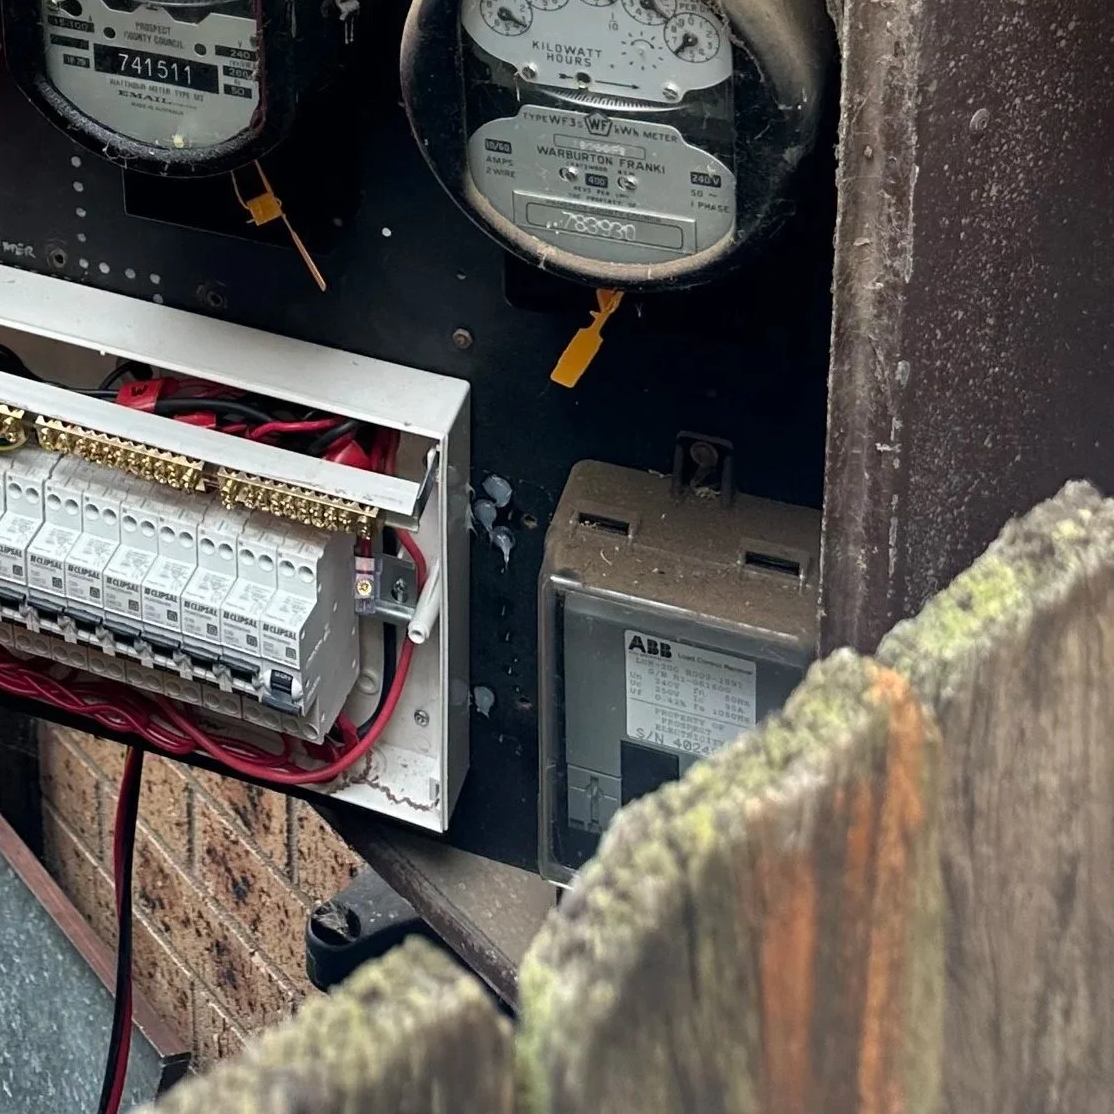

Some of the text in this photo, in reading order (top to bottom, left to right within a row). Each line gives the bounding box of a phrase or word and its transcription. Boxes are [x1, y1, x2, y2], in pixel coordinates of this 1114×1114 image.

[135, 22, 171, 35] PROSPECT
[154, 35, 183, 49] COUNCIL
[532, 40, 602, 58] KILOWATT
[547, 53, 591, 67] HOURS
[118, 53, 191, 85] 741511
[175, 88, 190, 100] TYPE
[523, 112, 546, 123] TYPE
[588, 118, 608, 131] WF
[643, 131, 678, 142] METER
[486, 155, 514, 166] AMPS
[537, 145, 613, 165] WARBURTON
[619, 158, 665, 174] FRANKI
[494, 168, 516, 178] WIRE
[697, 201, 730, 213] PHASE
[36, 556, 62, 570] CLIPSAL
[73, 565, 100, 580] CLIPSAL
[112, 577, 139, 592] CLIPSAL
[150, 588, 177, 603] CLIPSAL
[190, 602, 217, 617] CLIPSAL
[230, 613, 257, 627] CLIPSAL
[269, 625, 297, 641] CLIPSAL
[628, 635, 672, 658] ABB
[655, 707, 705, 726] PROPERTY
[662, 717, 713, 736] PROSPECT
[636, 727, 664, 744] S/N
